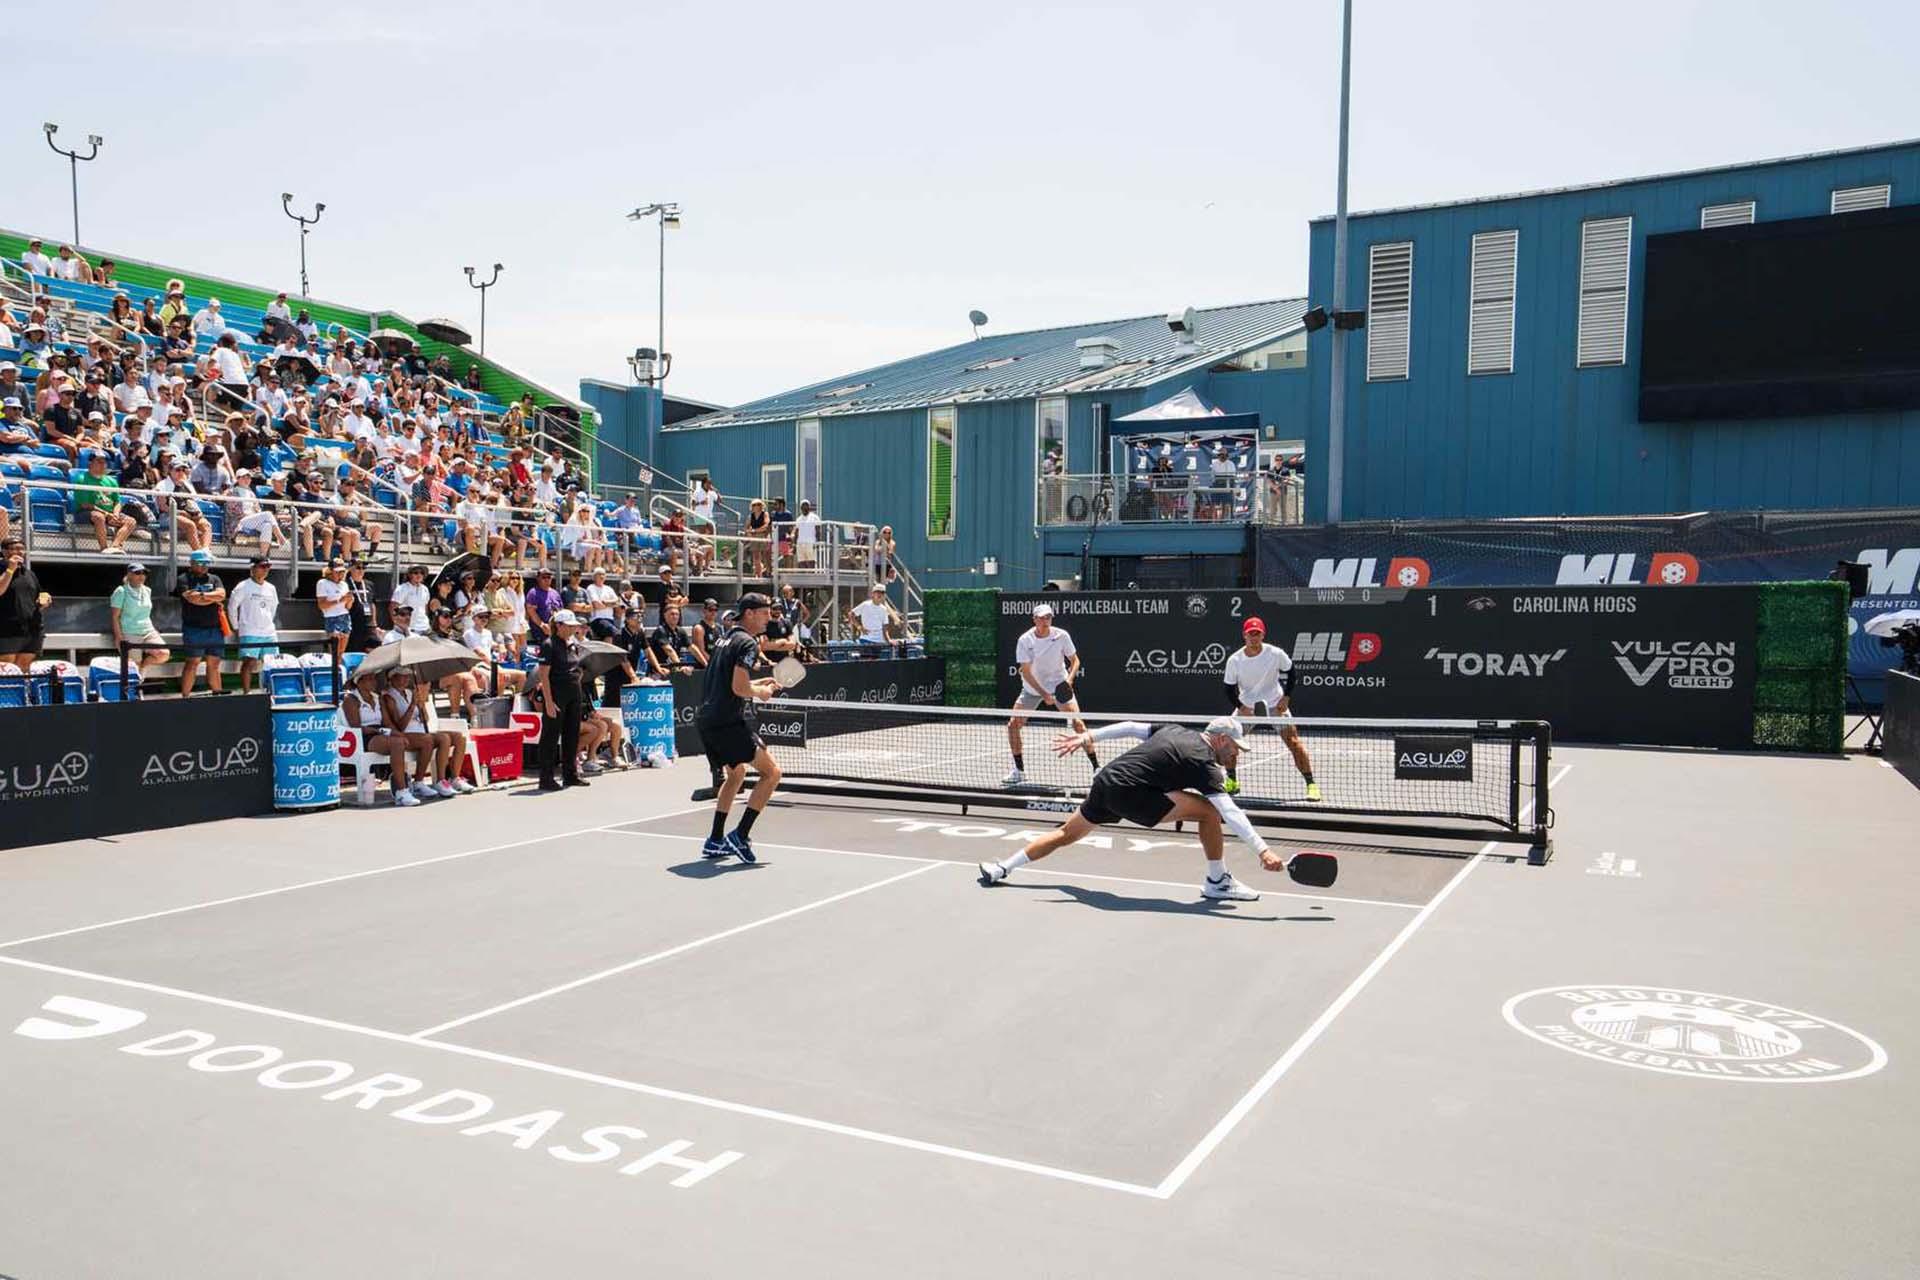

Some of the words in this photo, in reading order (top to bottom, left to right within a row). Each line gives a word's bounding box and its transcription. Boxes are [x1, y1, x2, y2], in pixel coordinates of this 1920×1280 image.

[1317, 590, 1345, 602] WINS
[1851, 600, 1918, 609] RESENTED
[1002, 600, 1060, 615] BROON
[1063, 601, 1132, 615] PICKLEBALL
[1135, 601, 1169, 614] TEAM
[1231, 596, 1242, 617] 2
[1428, 595, 1437, 616] 1
[1513, 597, 1589, 613] CAROLINA
[1594, 597, 1637, 613] HOGS
[1292, 632, 1382, 671] MLP
[1611, 641, 1735, 656] VULCAN
[1125, 667, 1169, 675] ALKALINE
[1303, 676, 1386, 688] DOORDASH
[1670, 677, 1731, 687] FLIGHT
[287, 715, 331, 734] zipfizz
[142, 773, 196, 787] ALKALINE
[199, 767, 260, 780] HYDRATION
[288, 761, 332, 779] zipfizz
[14, 784, 89, 800] HYDRATION
[1554, 990, 1826, 1030] BROOKLYN
[1534, 1024, 1743, 1076] PICKLEBALL
[1746, 1056, 1843, 1077] TEAM
[117, 1029, 746, 1189] DOORDASH
